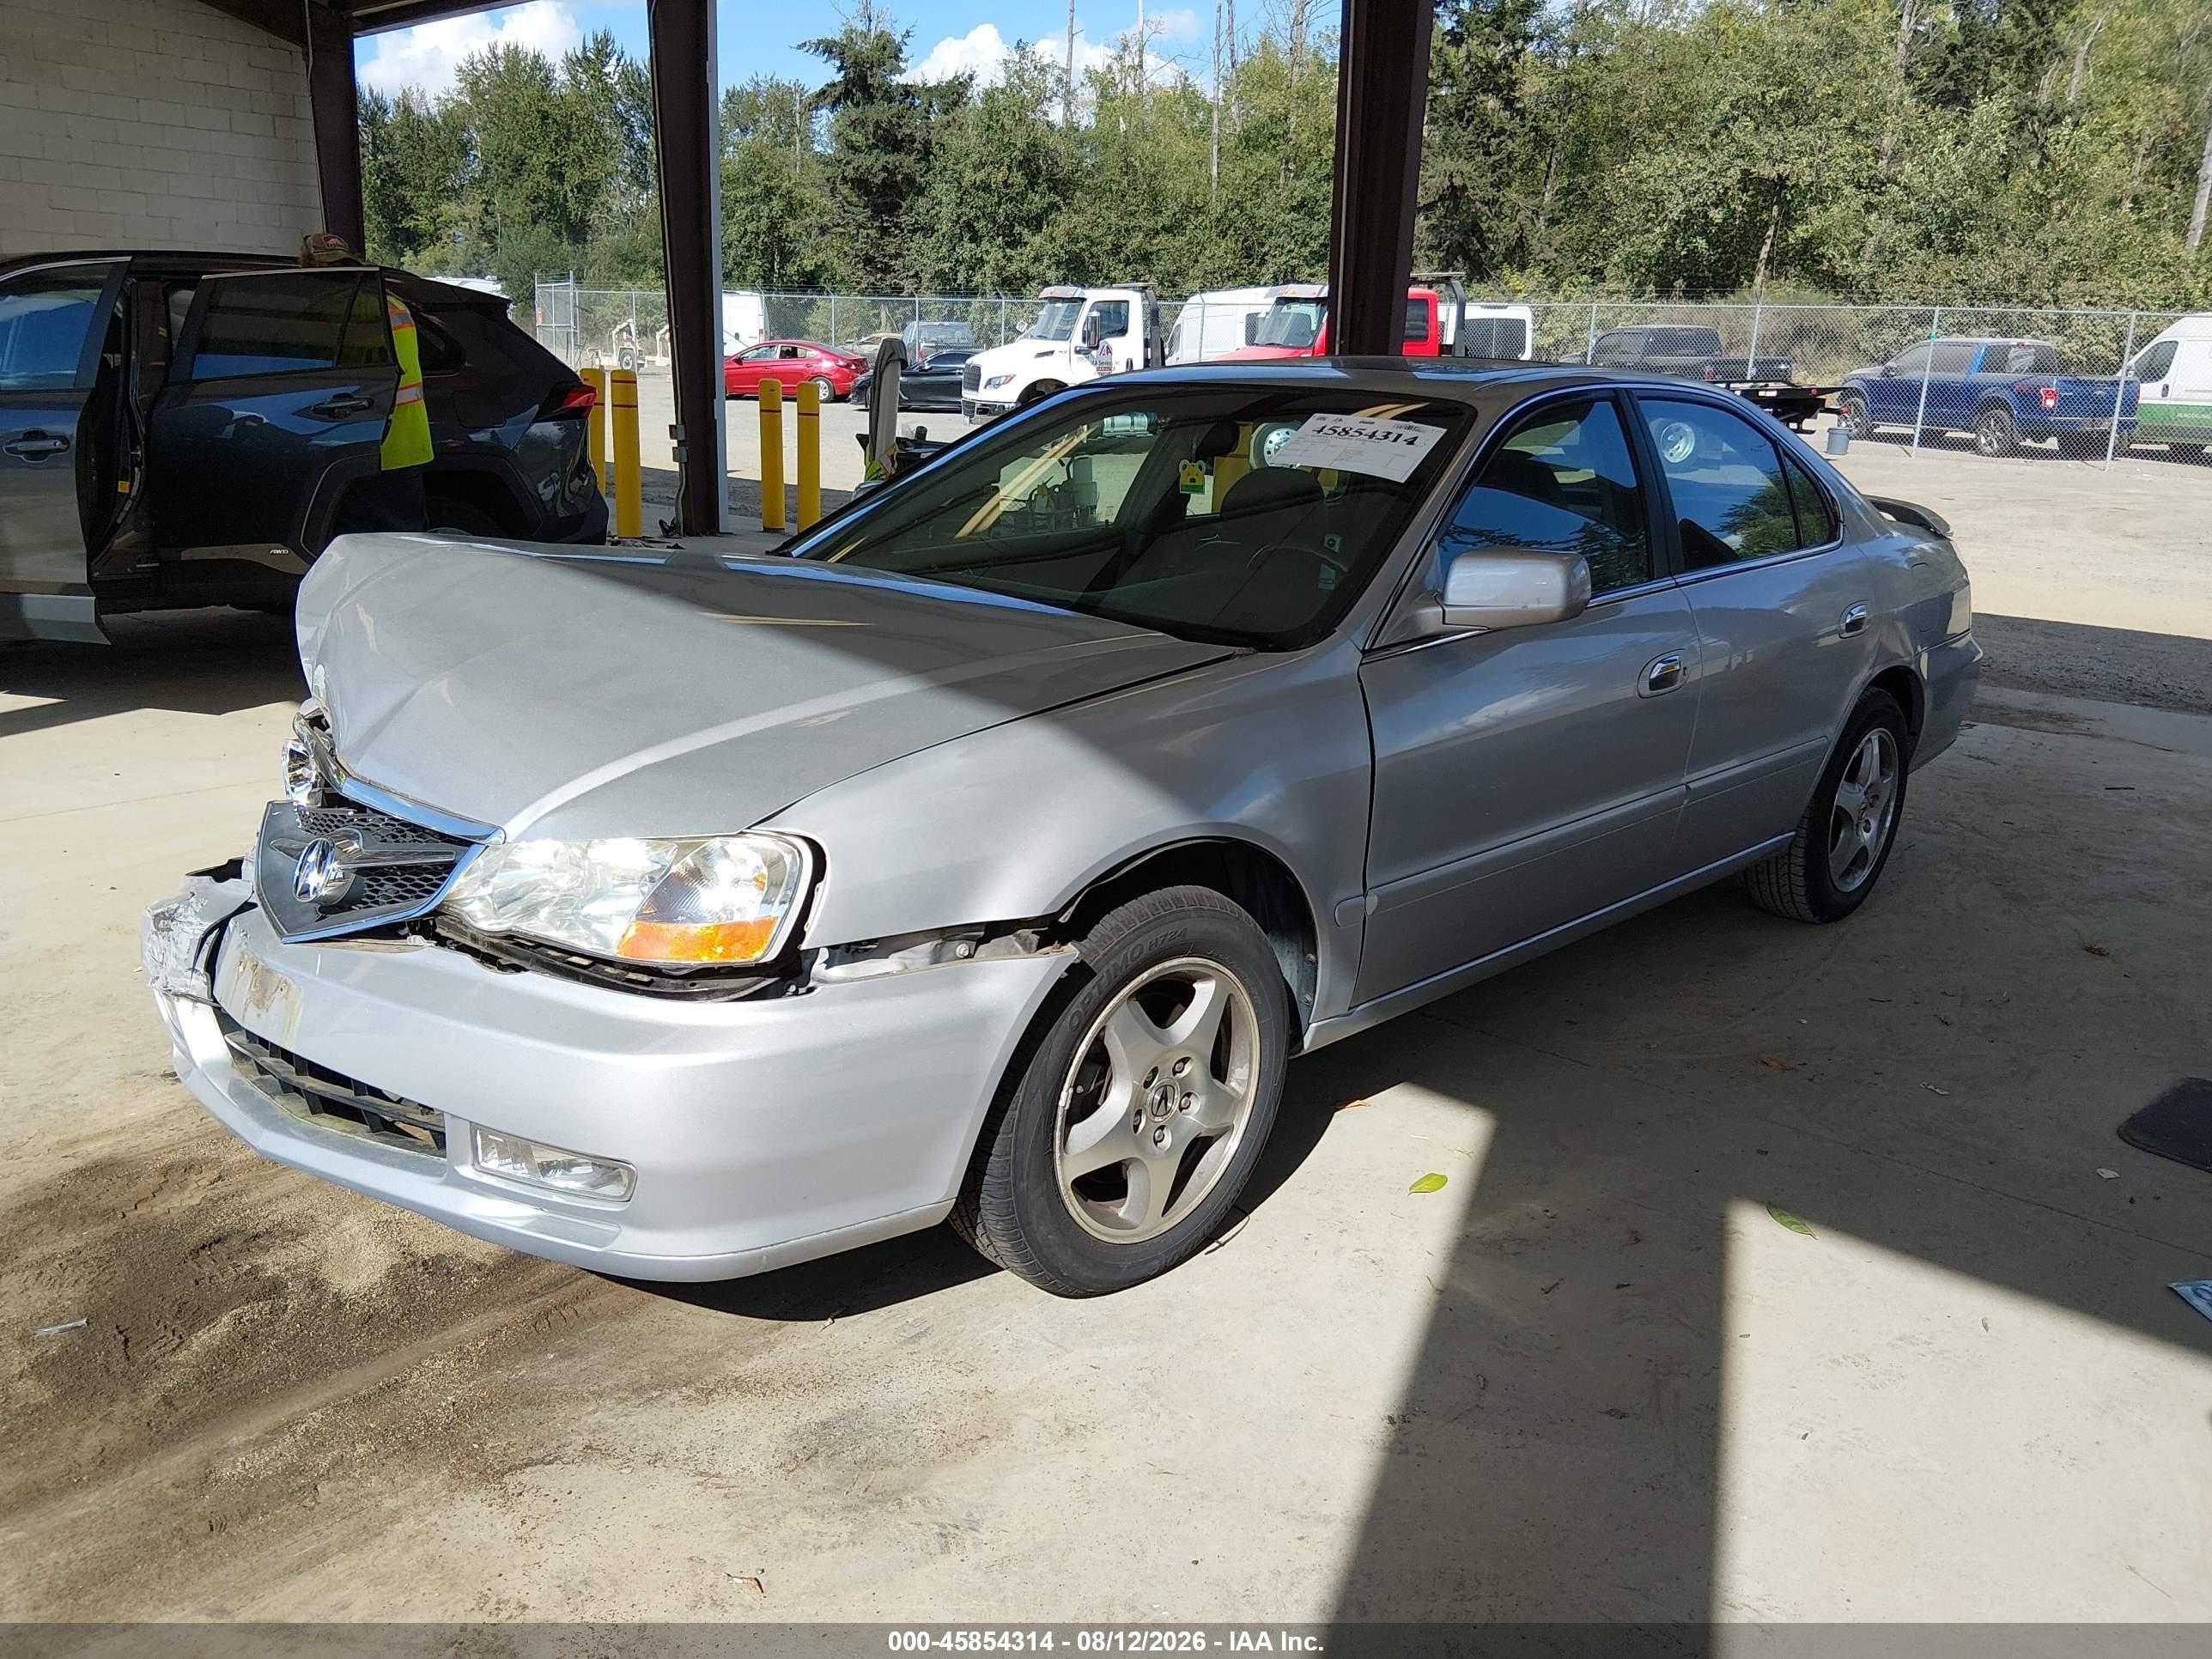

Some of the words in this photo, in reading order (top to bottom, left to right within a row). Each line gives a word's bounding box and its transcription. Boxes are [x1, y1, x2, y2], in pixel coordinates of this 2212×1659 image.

[1312, 424, 1419, 447] 45854314
[1068, 943, 1146, 1030] OPTIMO
[1147, 927, 1188, 951] H724
